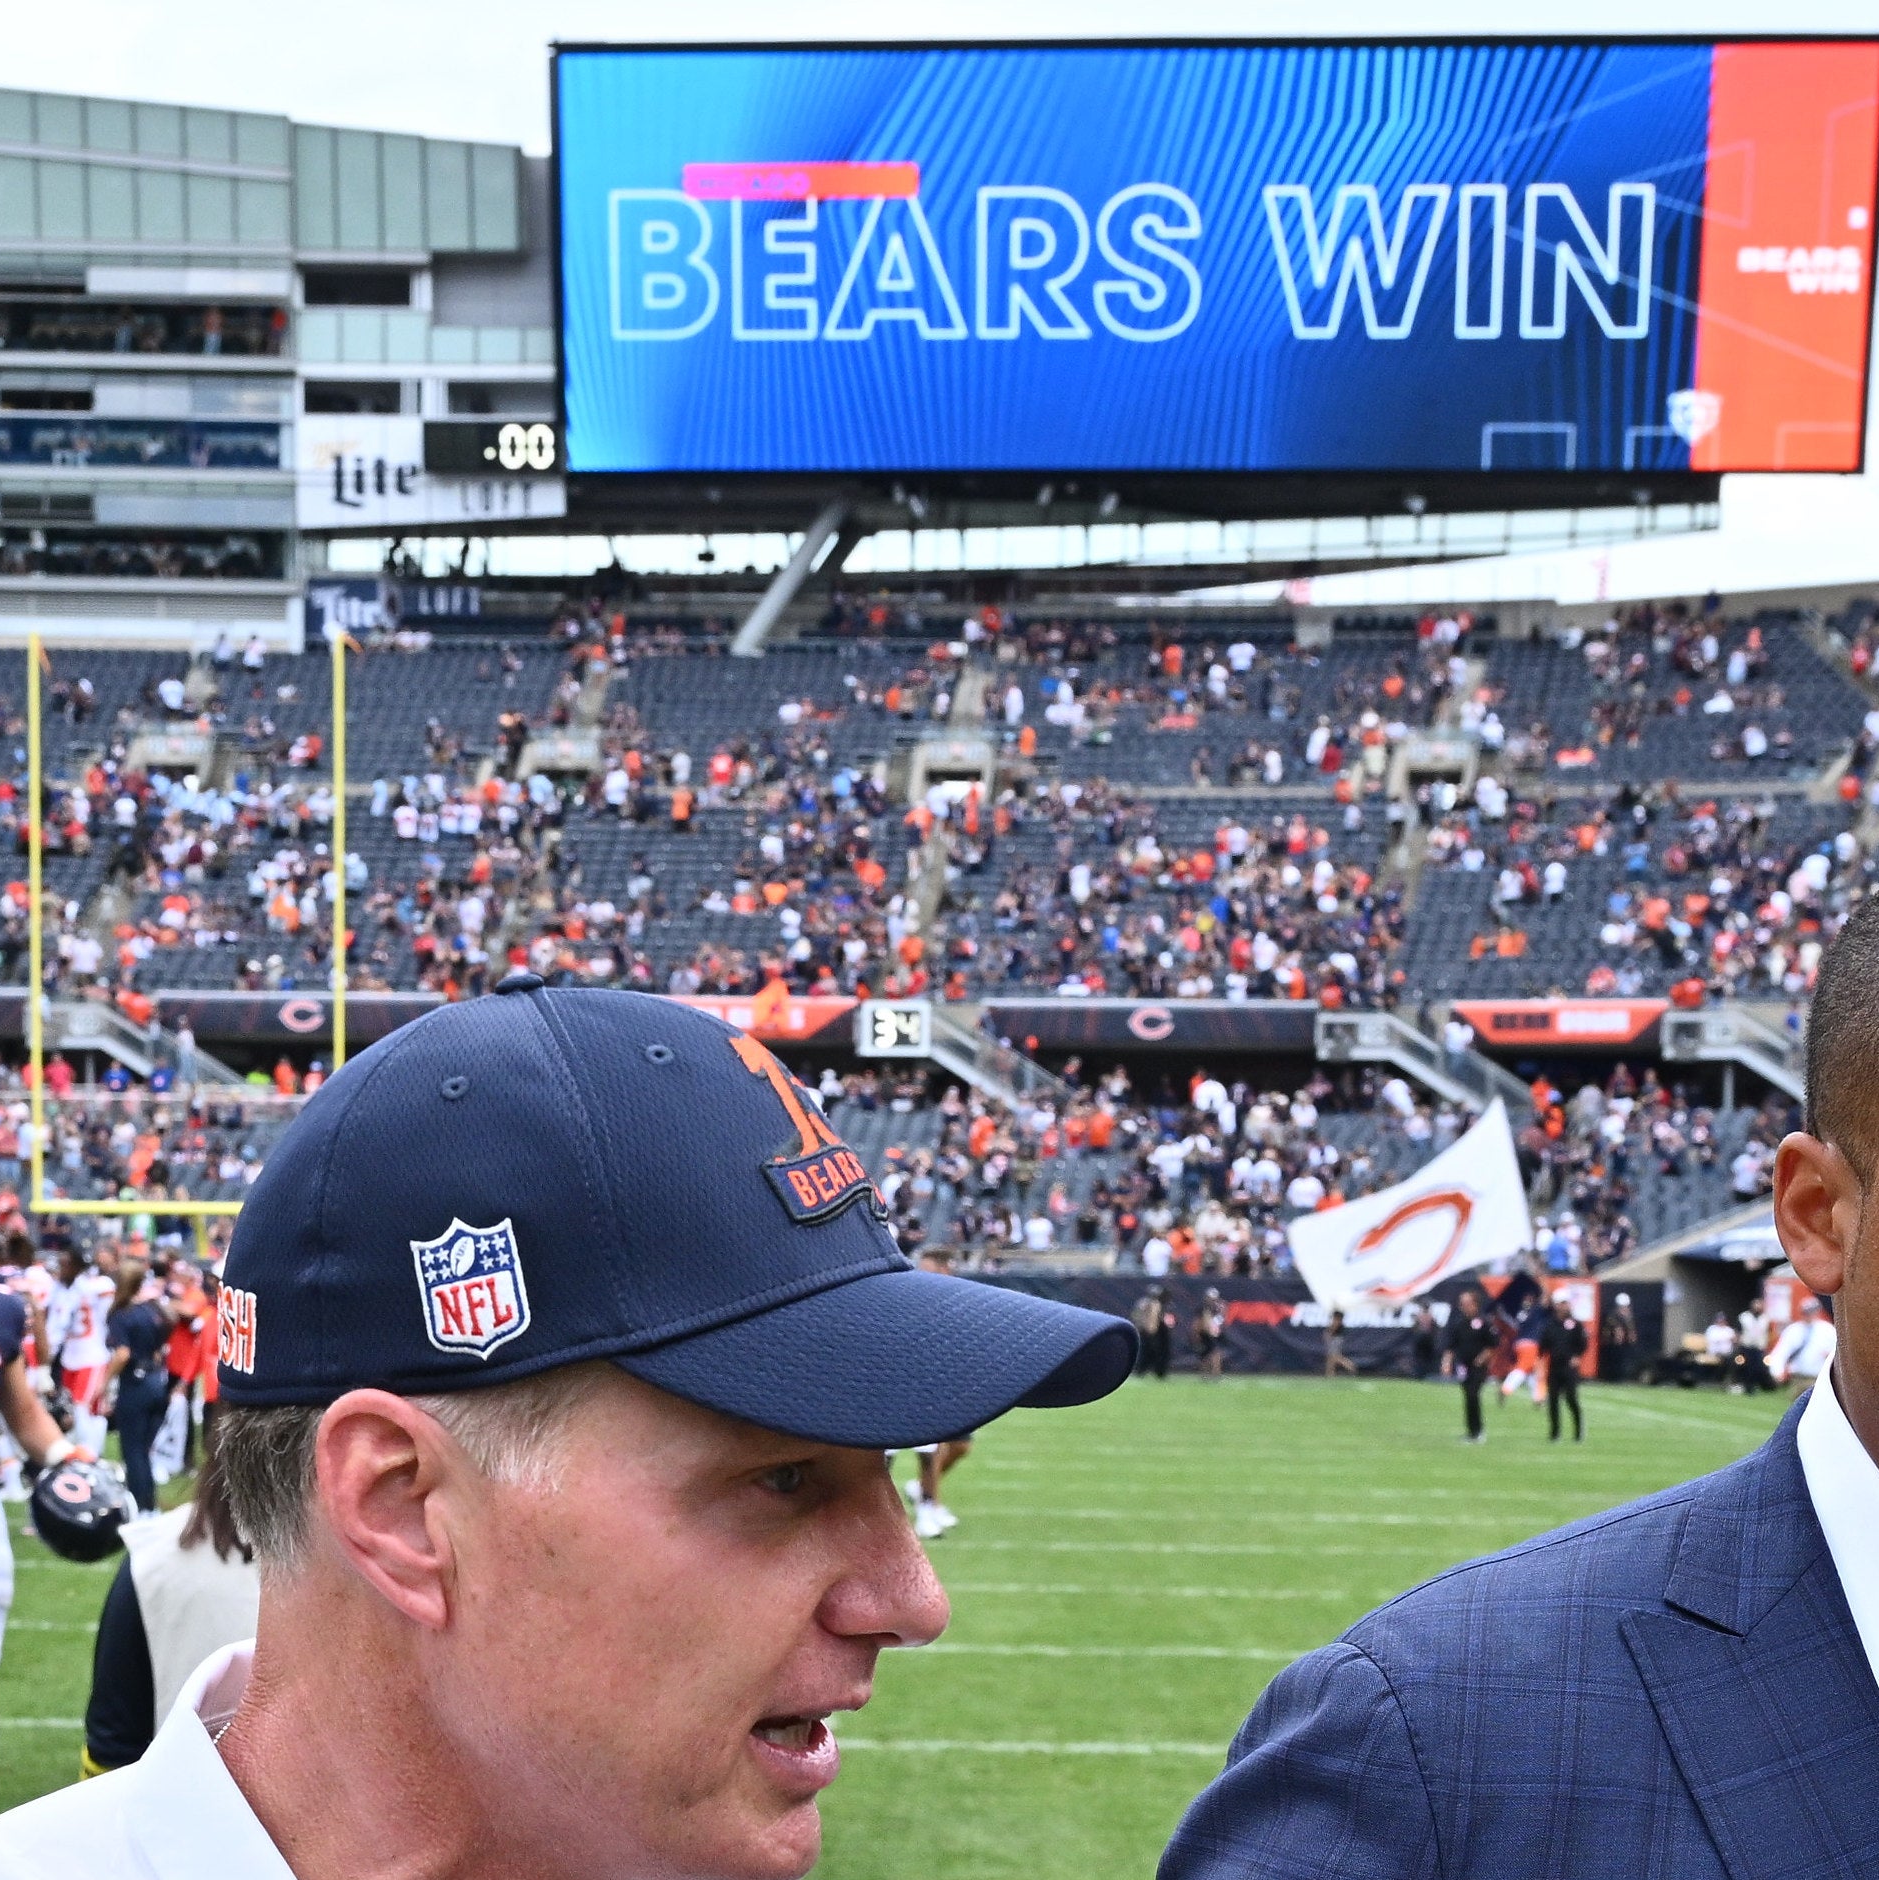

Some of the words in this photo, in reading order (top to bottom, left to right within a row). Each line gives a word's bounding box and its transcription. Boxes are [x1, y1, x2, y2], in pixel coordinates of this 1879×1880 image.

[608, 182, 1204, 342] BEARS
[1262, 183, 1658, 341] WIN
[1737, 246, 1862, 273] BEARS
[333, 453, 420, 508] Lite
[787, 1151, 868, 1209] BEARS
[216, 1281, 257, 1375] SH
[434, 1277, 514, 1338] NFL
